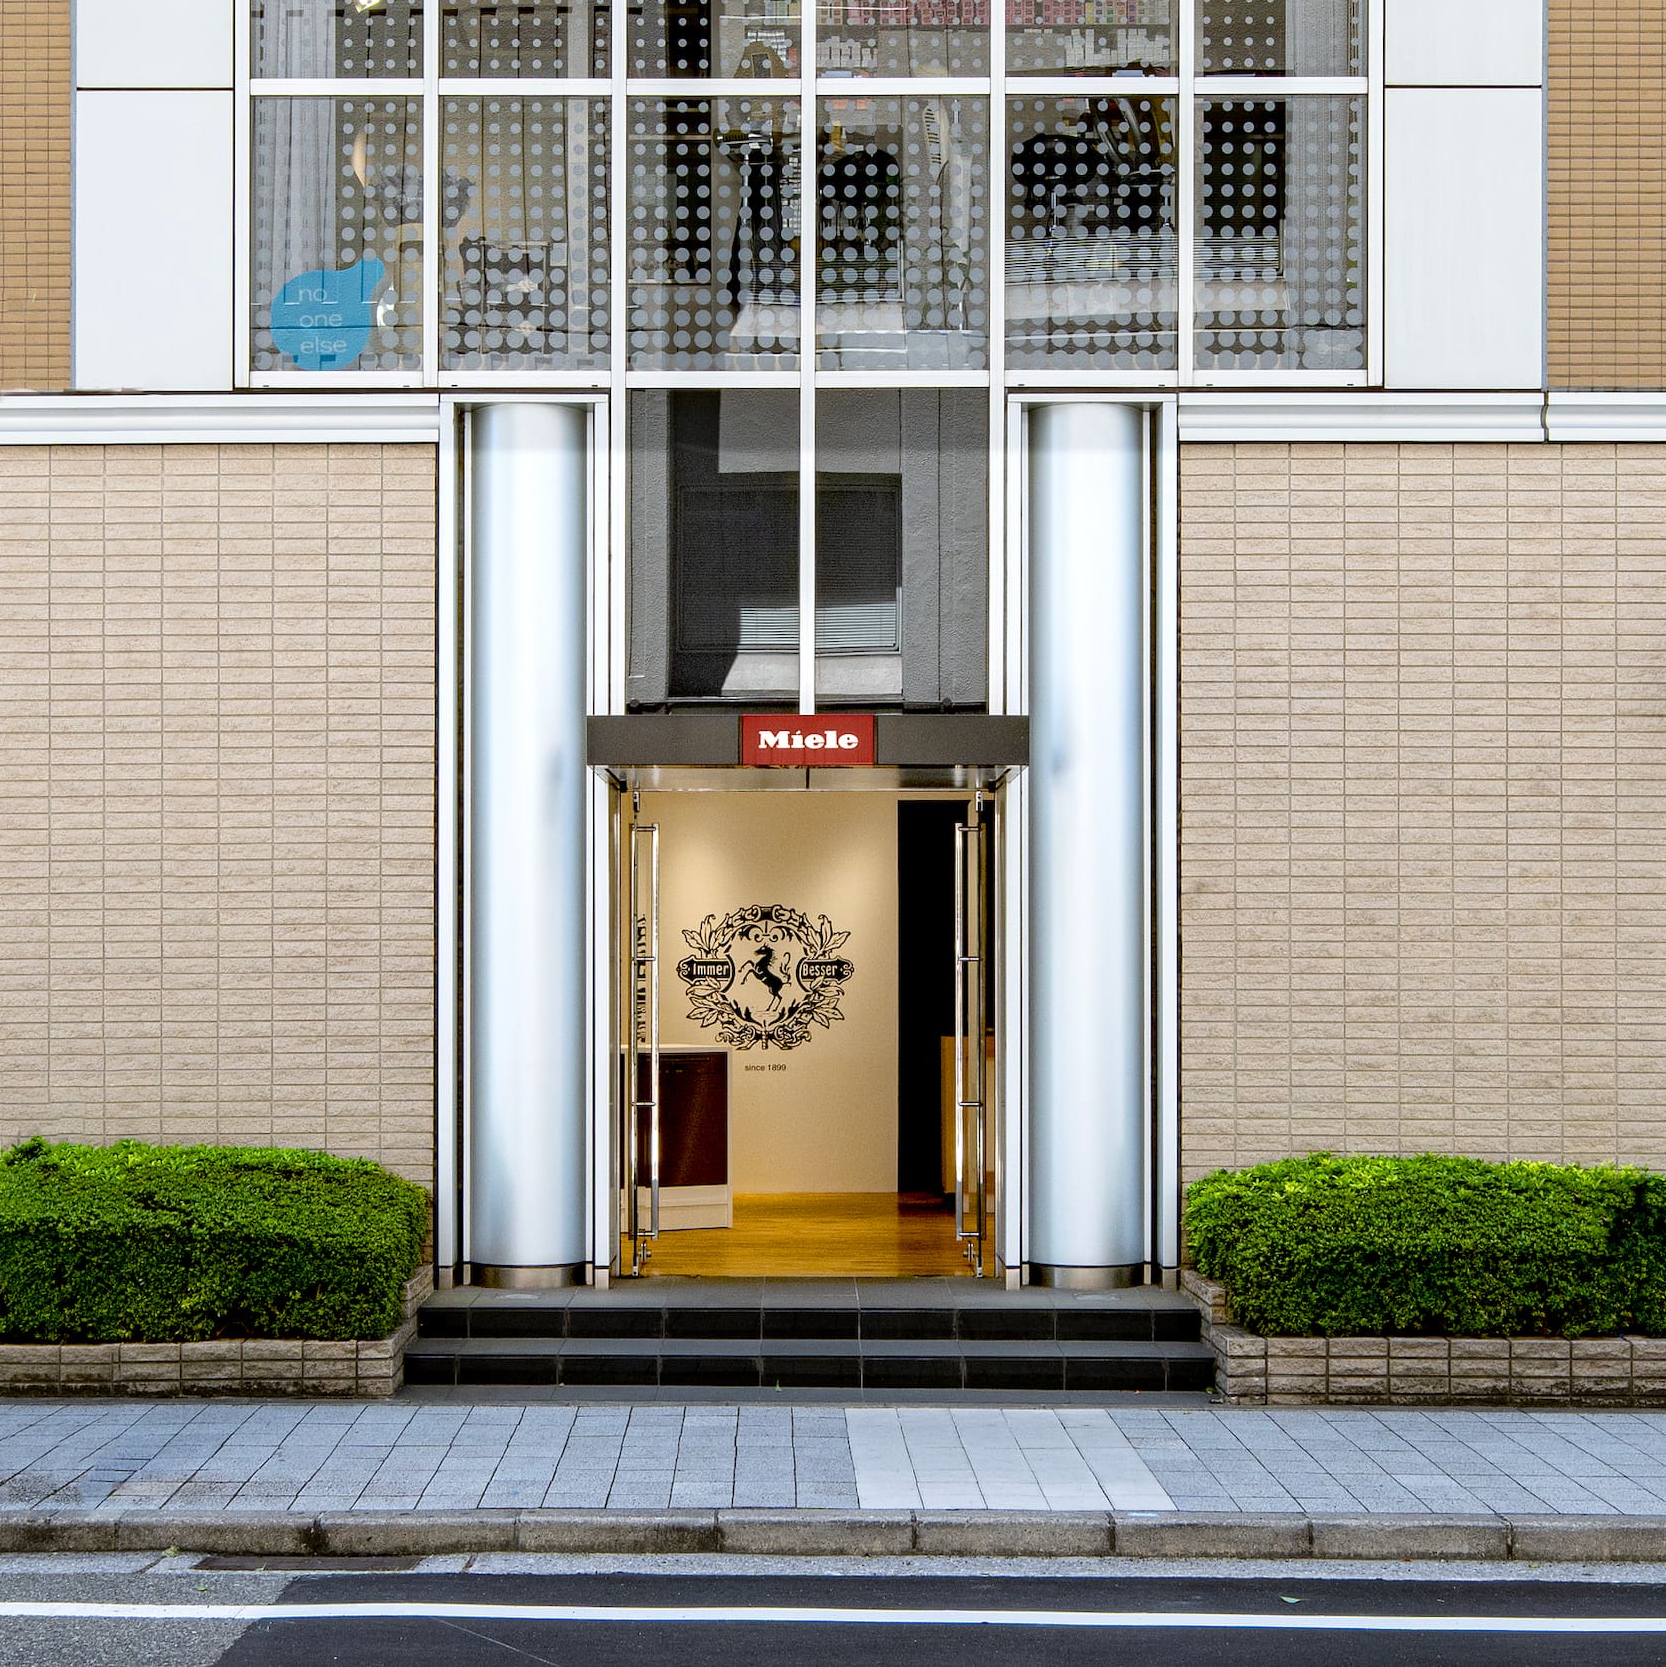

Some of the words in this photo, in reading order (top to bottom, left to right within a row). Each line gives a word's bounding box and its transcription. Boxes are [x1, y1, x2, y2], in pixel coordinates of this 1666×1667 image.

[299, 287, 327, 302] no
[299, 314, 342, 328] one
[300, 336, 347, 354] else
[758, 730, 859, 749] Miele
[692, 962, 730, 976] Immer
[802, 962, 837, 976] Besser
[744, 1063, 766, 1072] since
[767, 1063, 787, 1072] 1899
